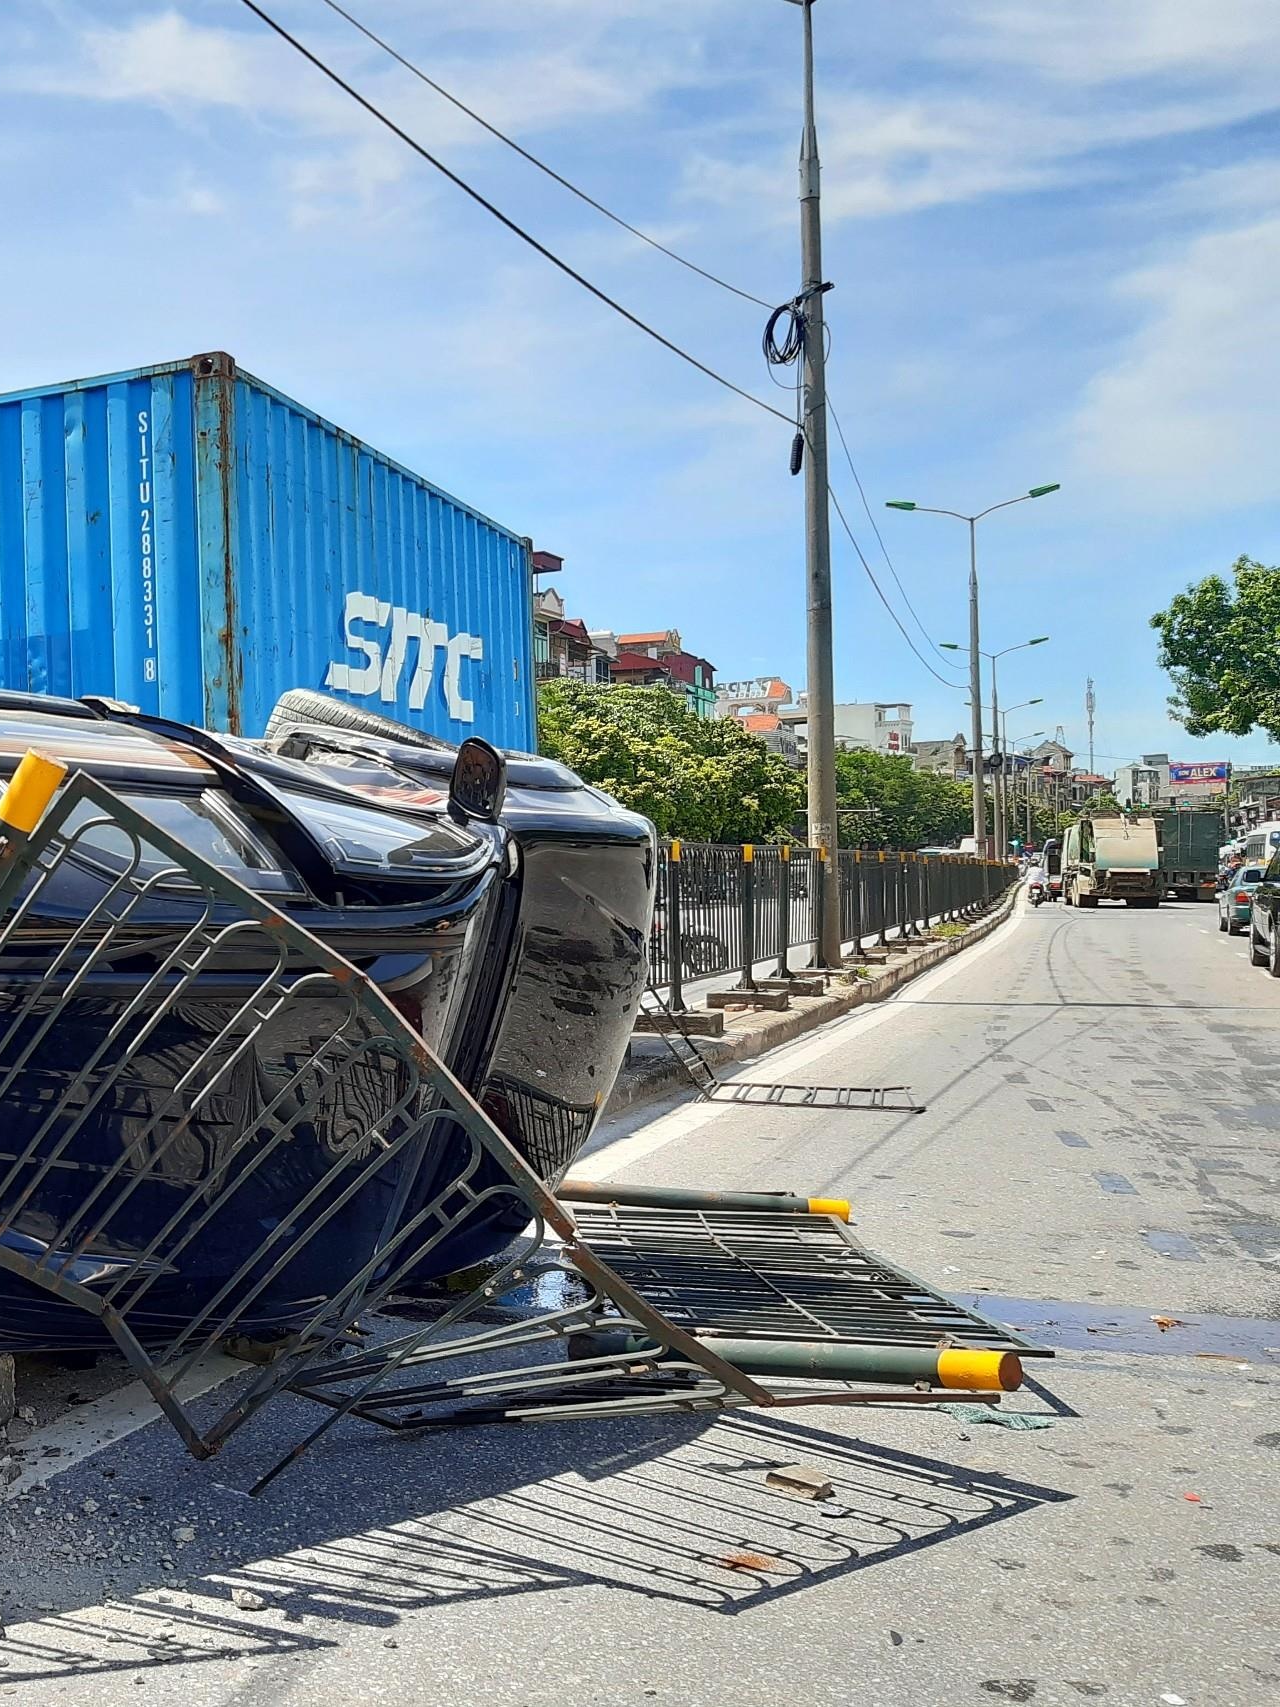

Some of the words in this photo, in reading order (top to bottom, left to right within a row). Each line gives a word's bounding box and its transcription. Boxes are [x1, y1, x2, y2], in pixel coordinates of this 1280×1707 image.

[138, 411, 151, 504] SITU
[141, 509, 154, 649] 288331
[145, 659, 155, 681] 8
[1190, 768, 1216, 777] ALEX
